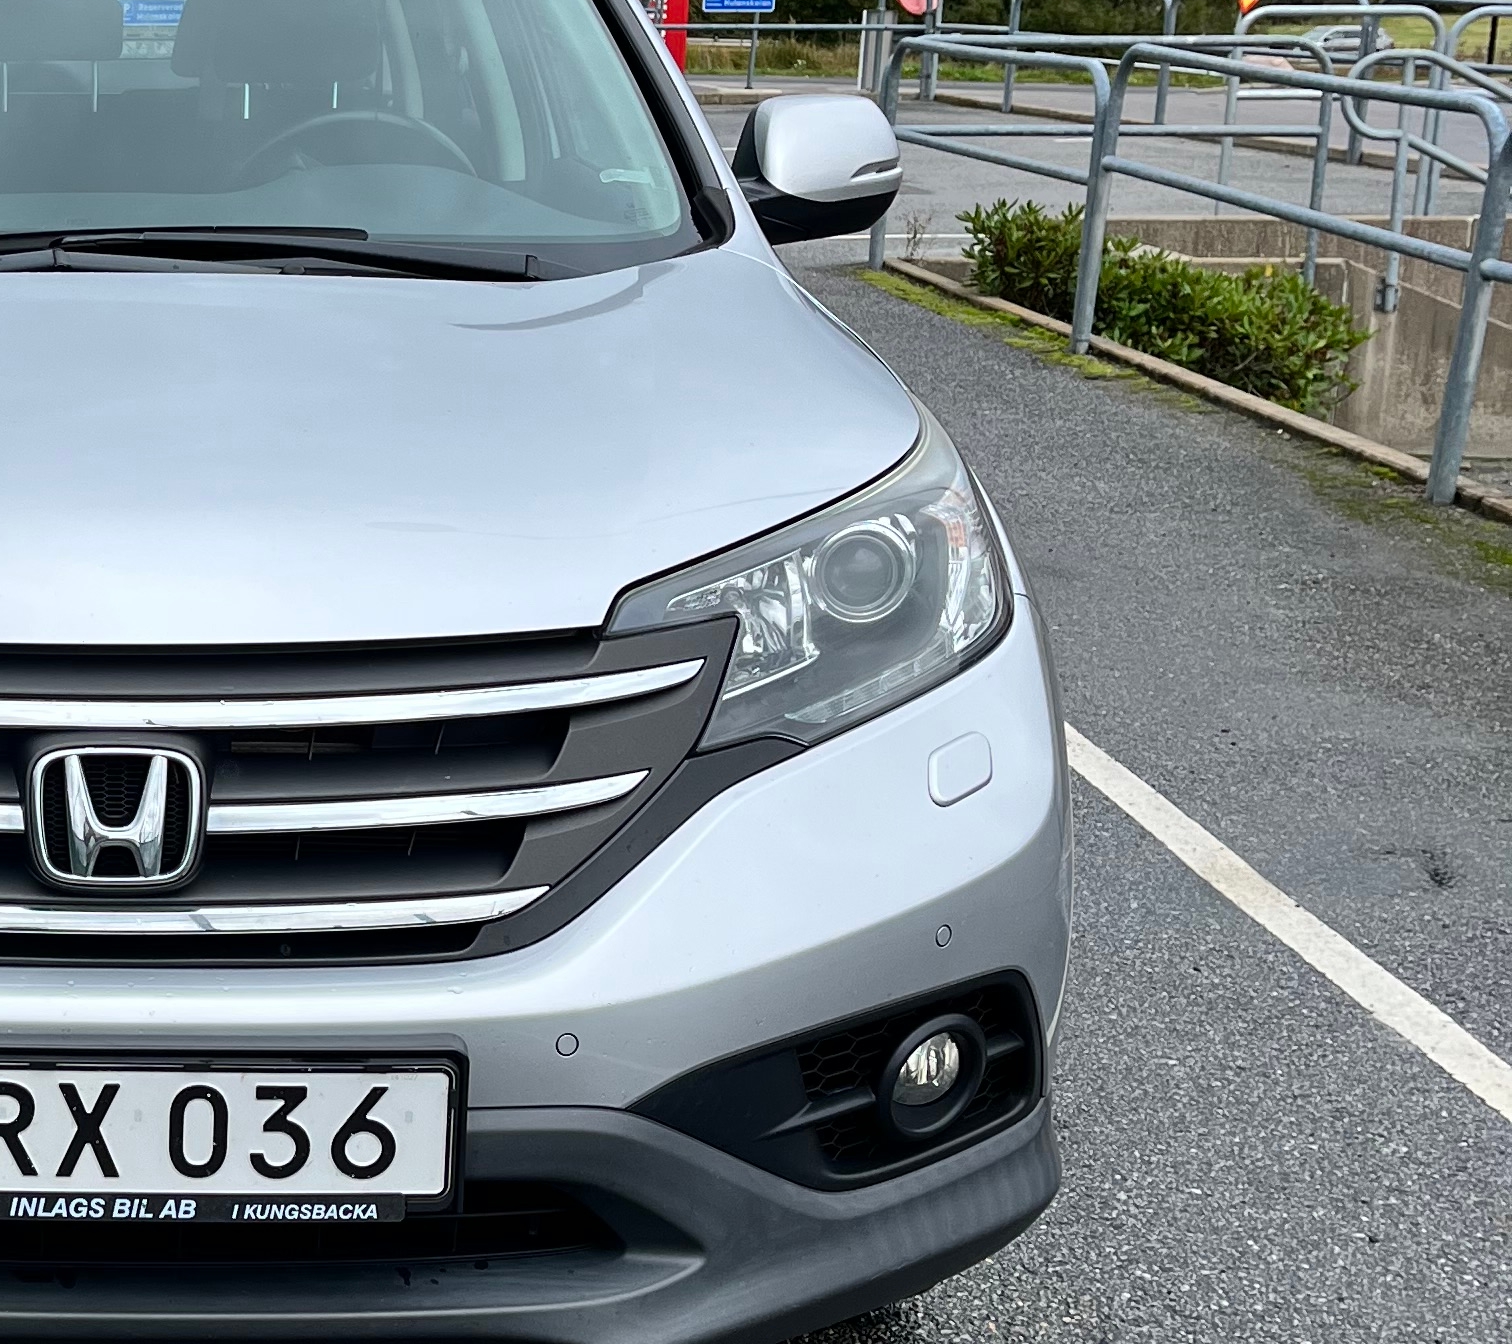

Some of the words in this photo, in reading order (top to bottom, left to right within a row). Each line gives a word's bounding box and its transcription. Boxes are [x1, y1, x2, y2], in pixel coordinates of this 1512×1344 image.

[169, 1083, 397, 1180] 036
[9, 1196, 106, 1218] INLAGS
[112, 1198, 154, 1218] BIL
[159, 1199, 197, 1219] AB
[231, 1204, 239, 1220] I
[243, 1203, 378, 1220] KUNGSBACKA
